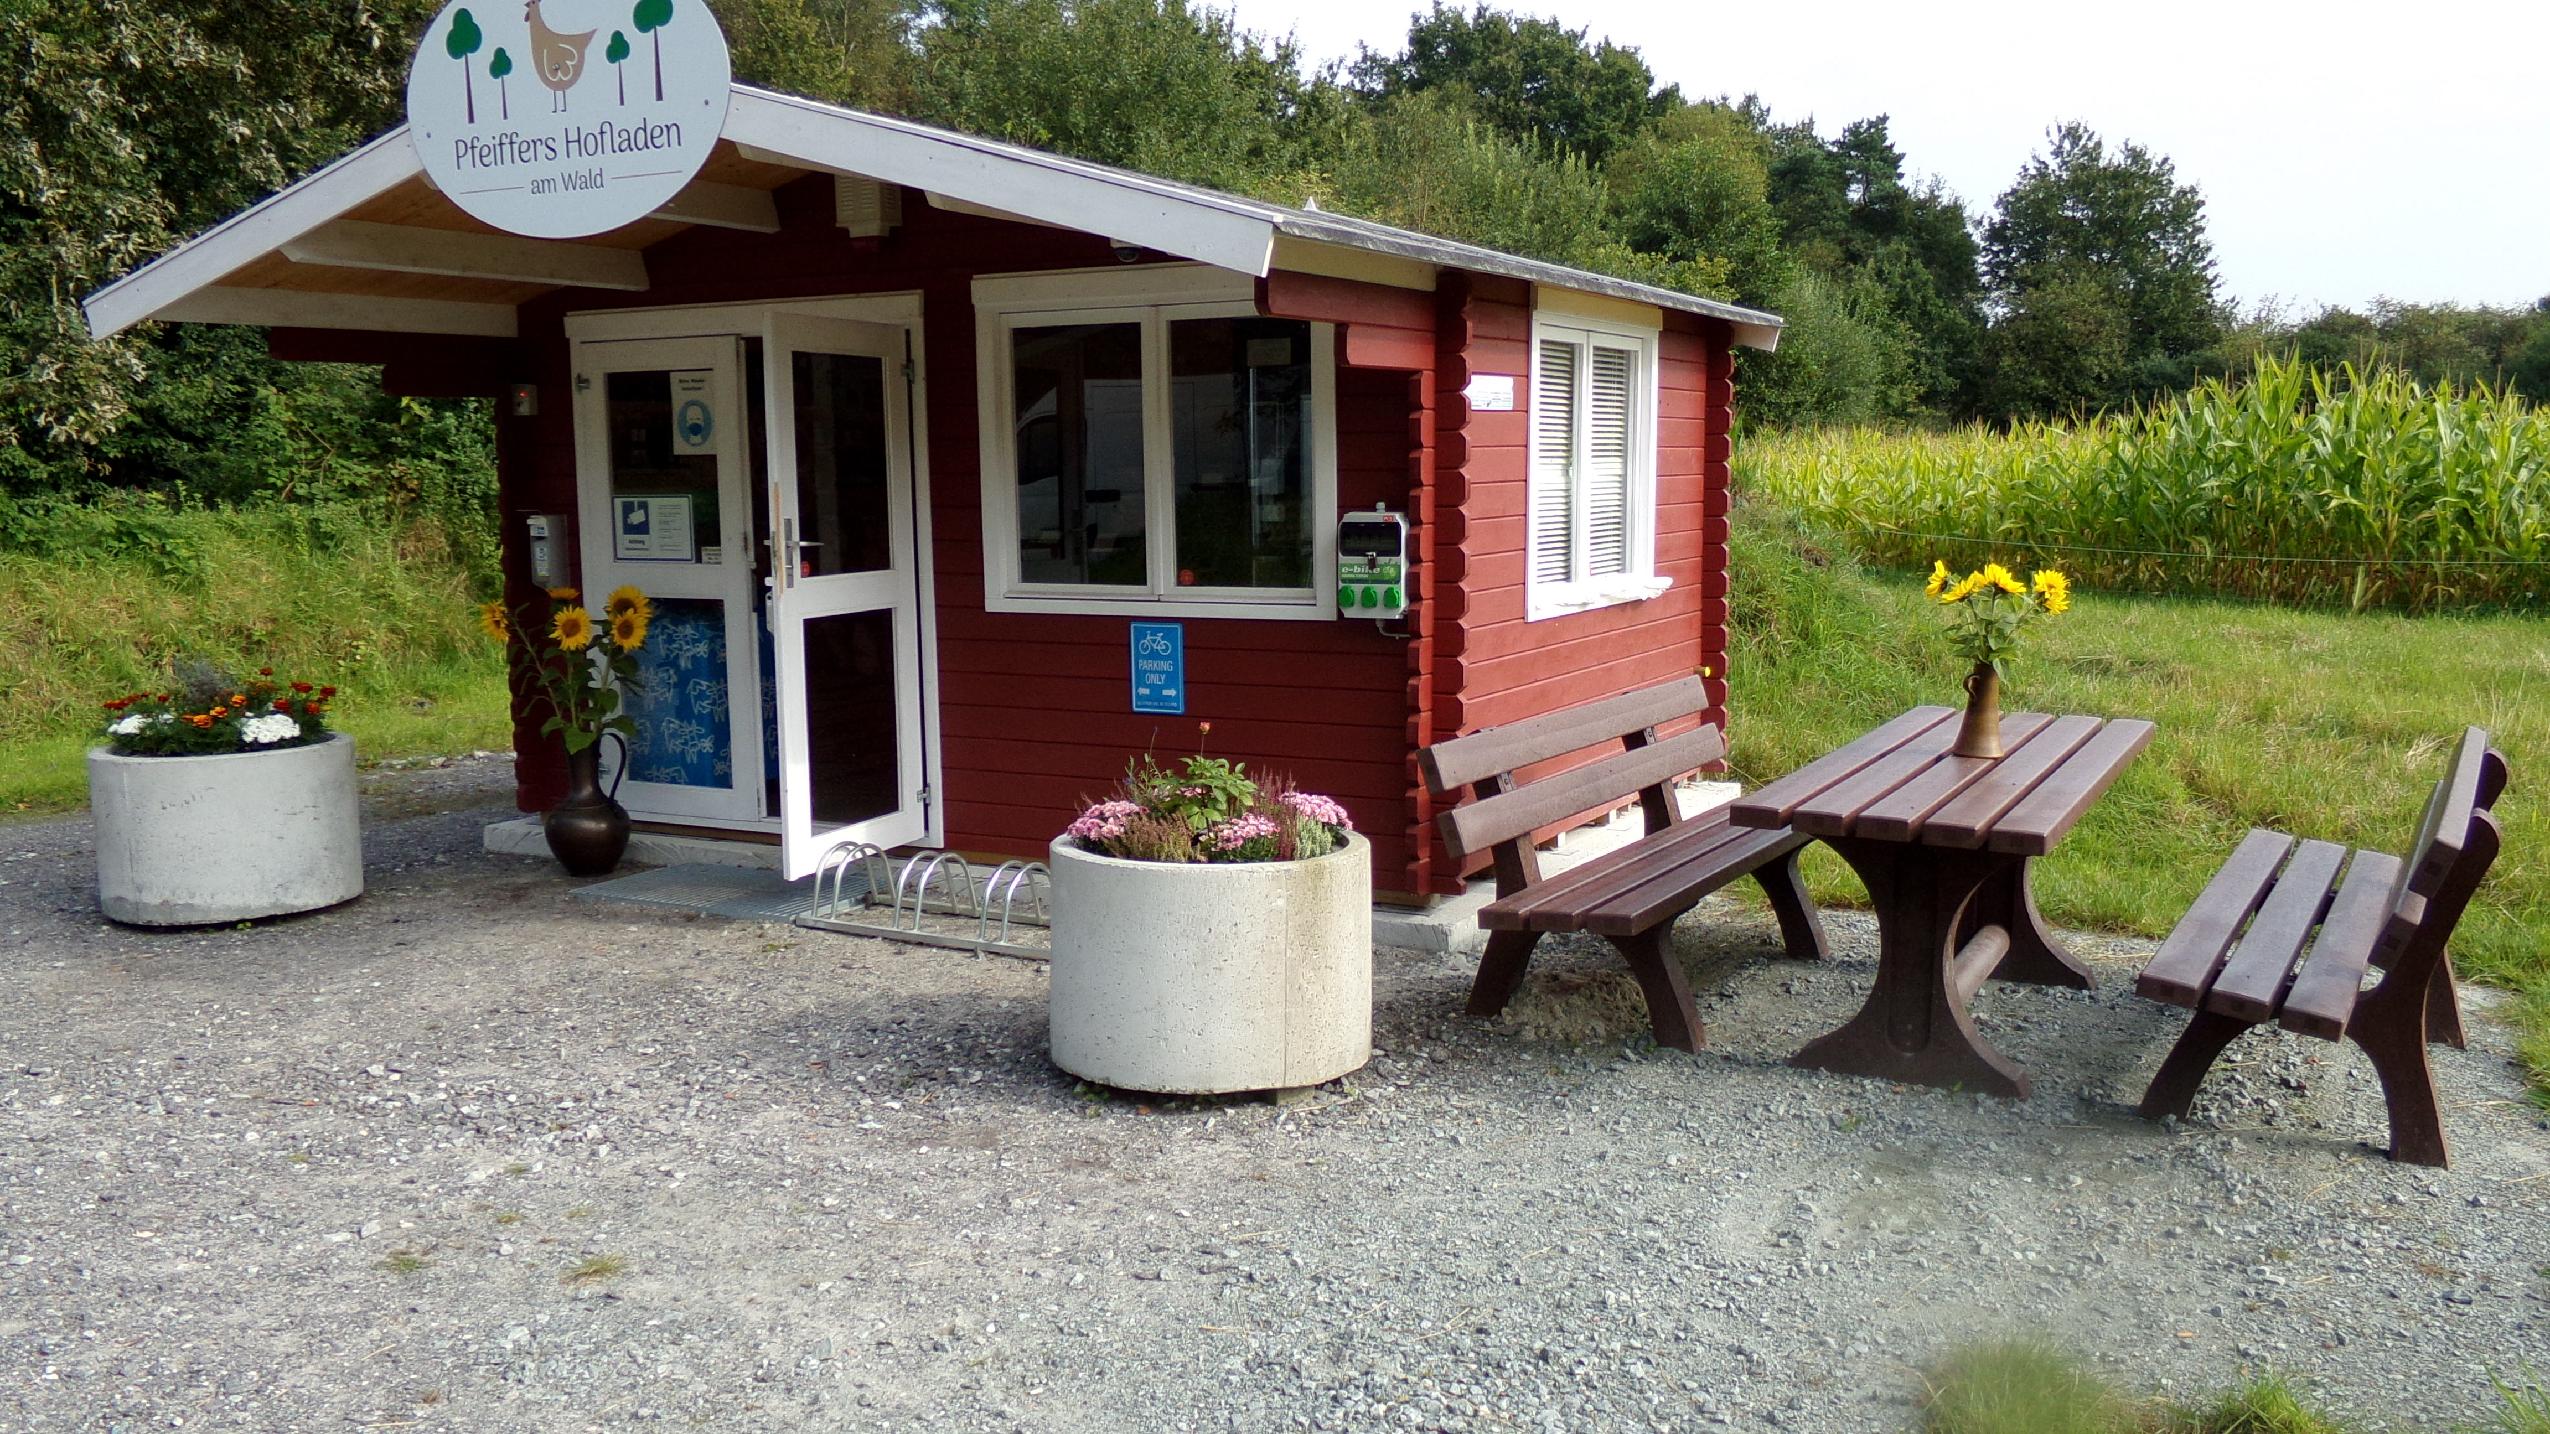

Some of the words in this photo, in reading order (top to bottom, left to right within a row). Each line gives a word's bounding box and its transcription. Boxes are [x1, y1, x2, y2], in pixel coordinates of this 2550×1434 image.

[455, 131, 558, 171] Pfeiffers
[564, 117, 682, 159] Hofladen
[530, 177, 557, 195] am
[560, 167, 605, 192] Wald
[1138, 659, 1173, 672] PARKING
[1145, 673, 1166, 685] ONLY
